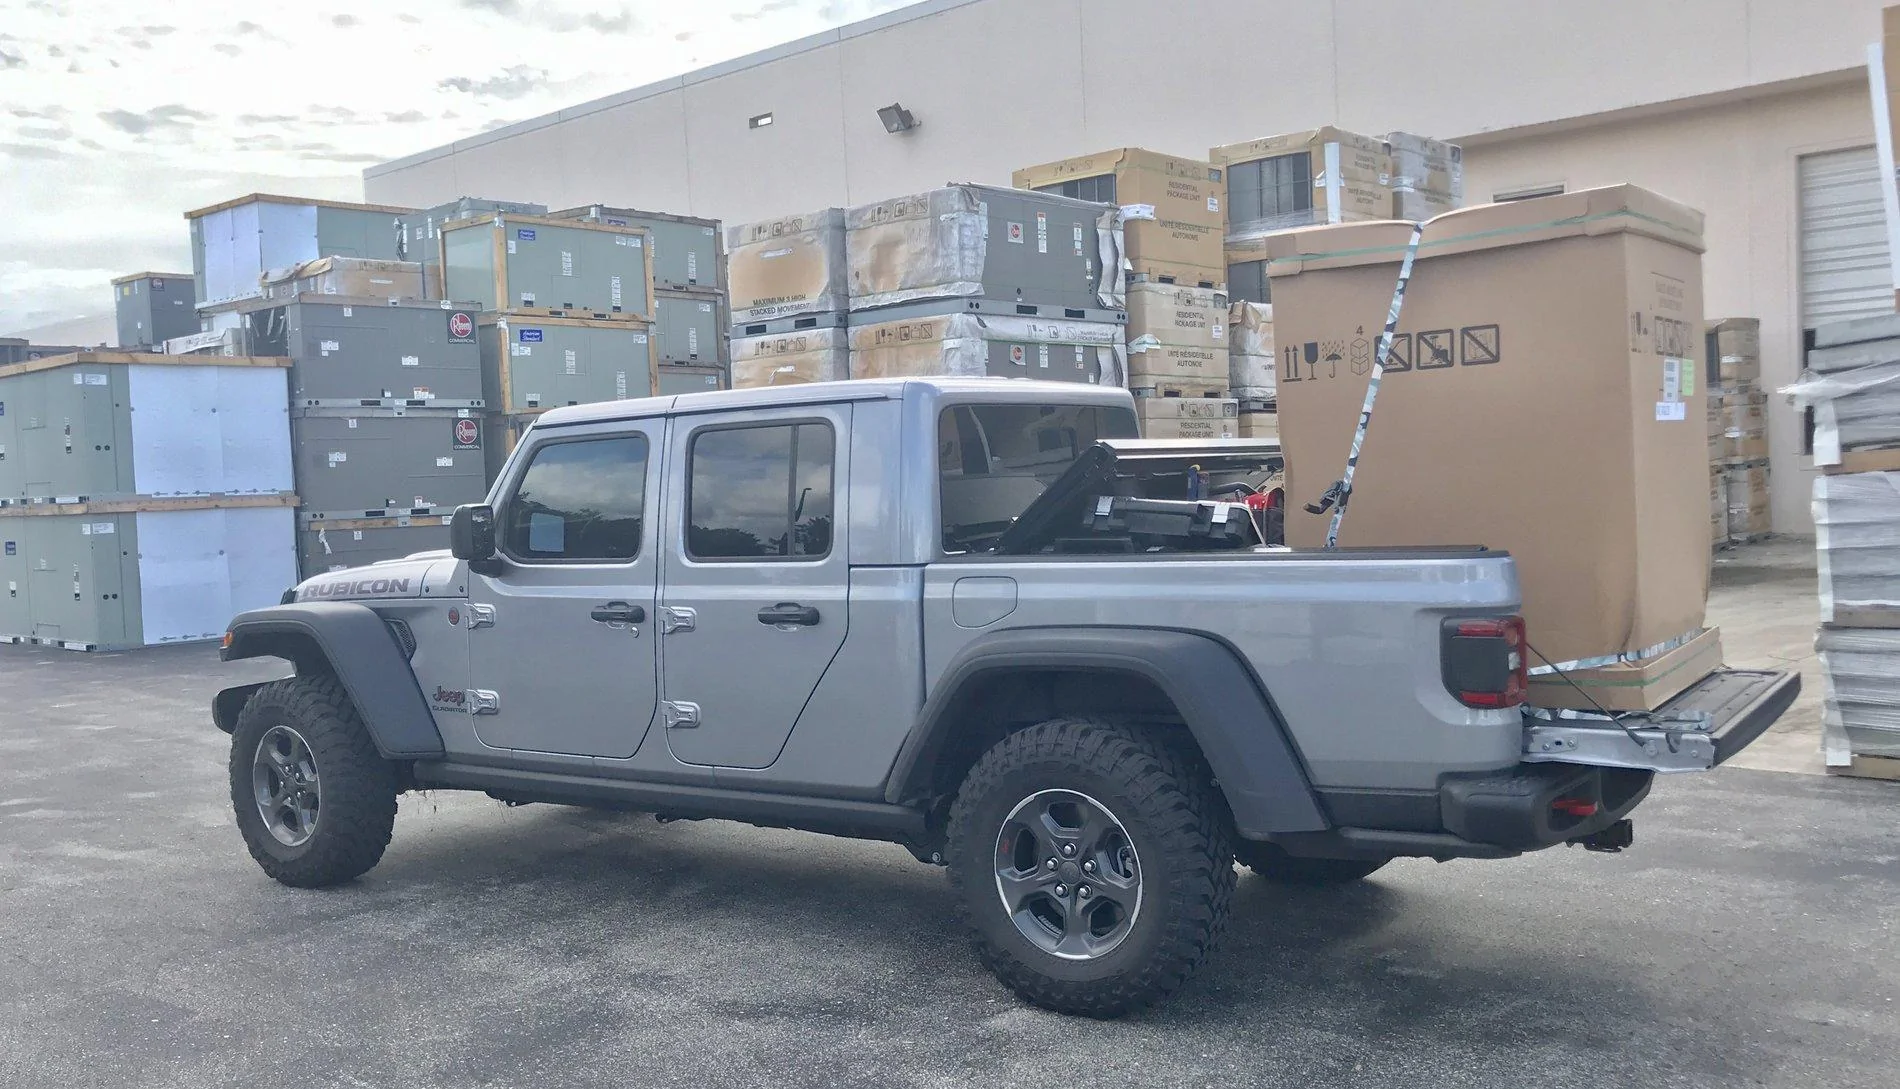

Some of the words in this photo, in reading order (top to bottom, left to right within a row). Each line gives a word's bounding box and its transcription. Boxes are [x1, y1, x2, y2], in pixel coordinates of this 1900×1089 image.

[750, 307, 776, 317] STACKED
[777, 303, 810, 312] MOVEMENT
[1356, 325, 1364, 336] 4
[302, 578, 410, 597] RUBICON
[433, 685, 465, 706] Jeep
[432, 705, 467, 713] GLADIATOR
